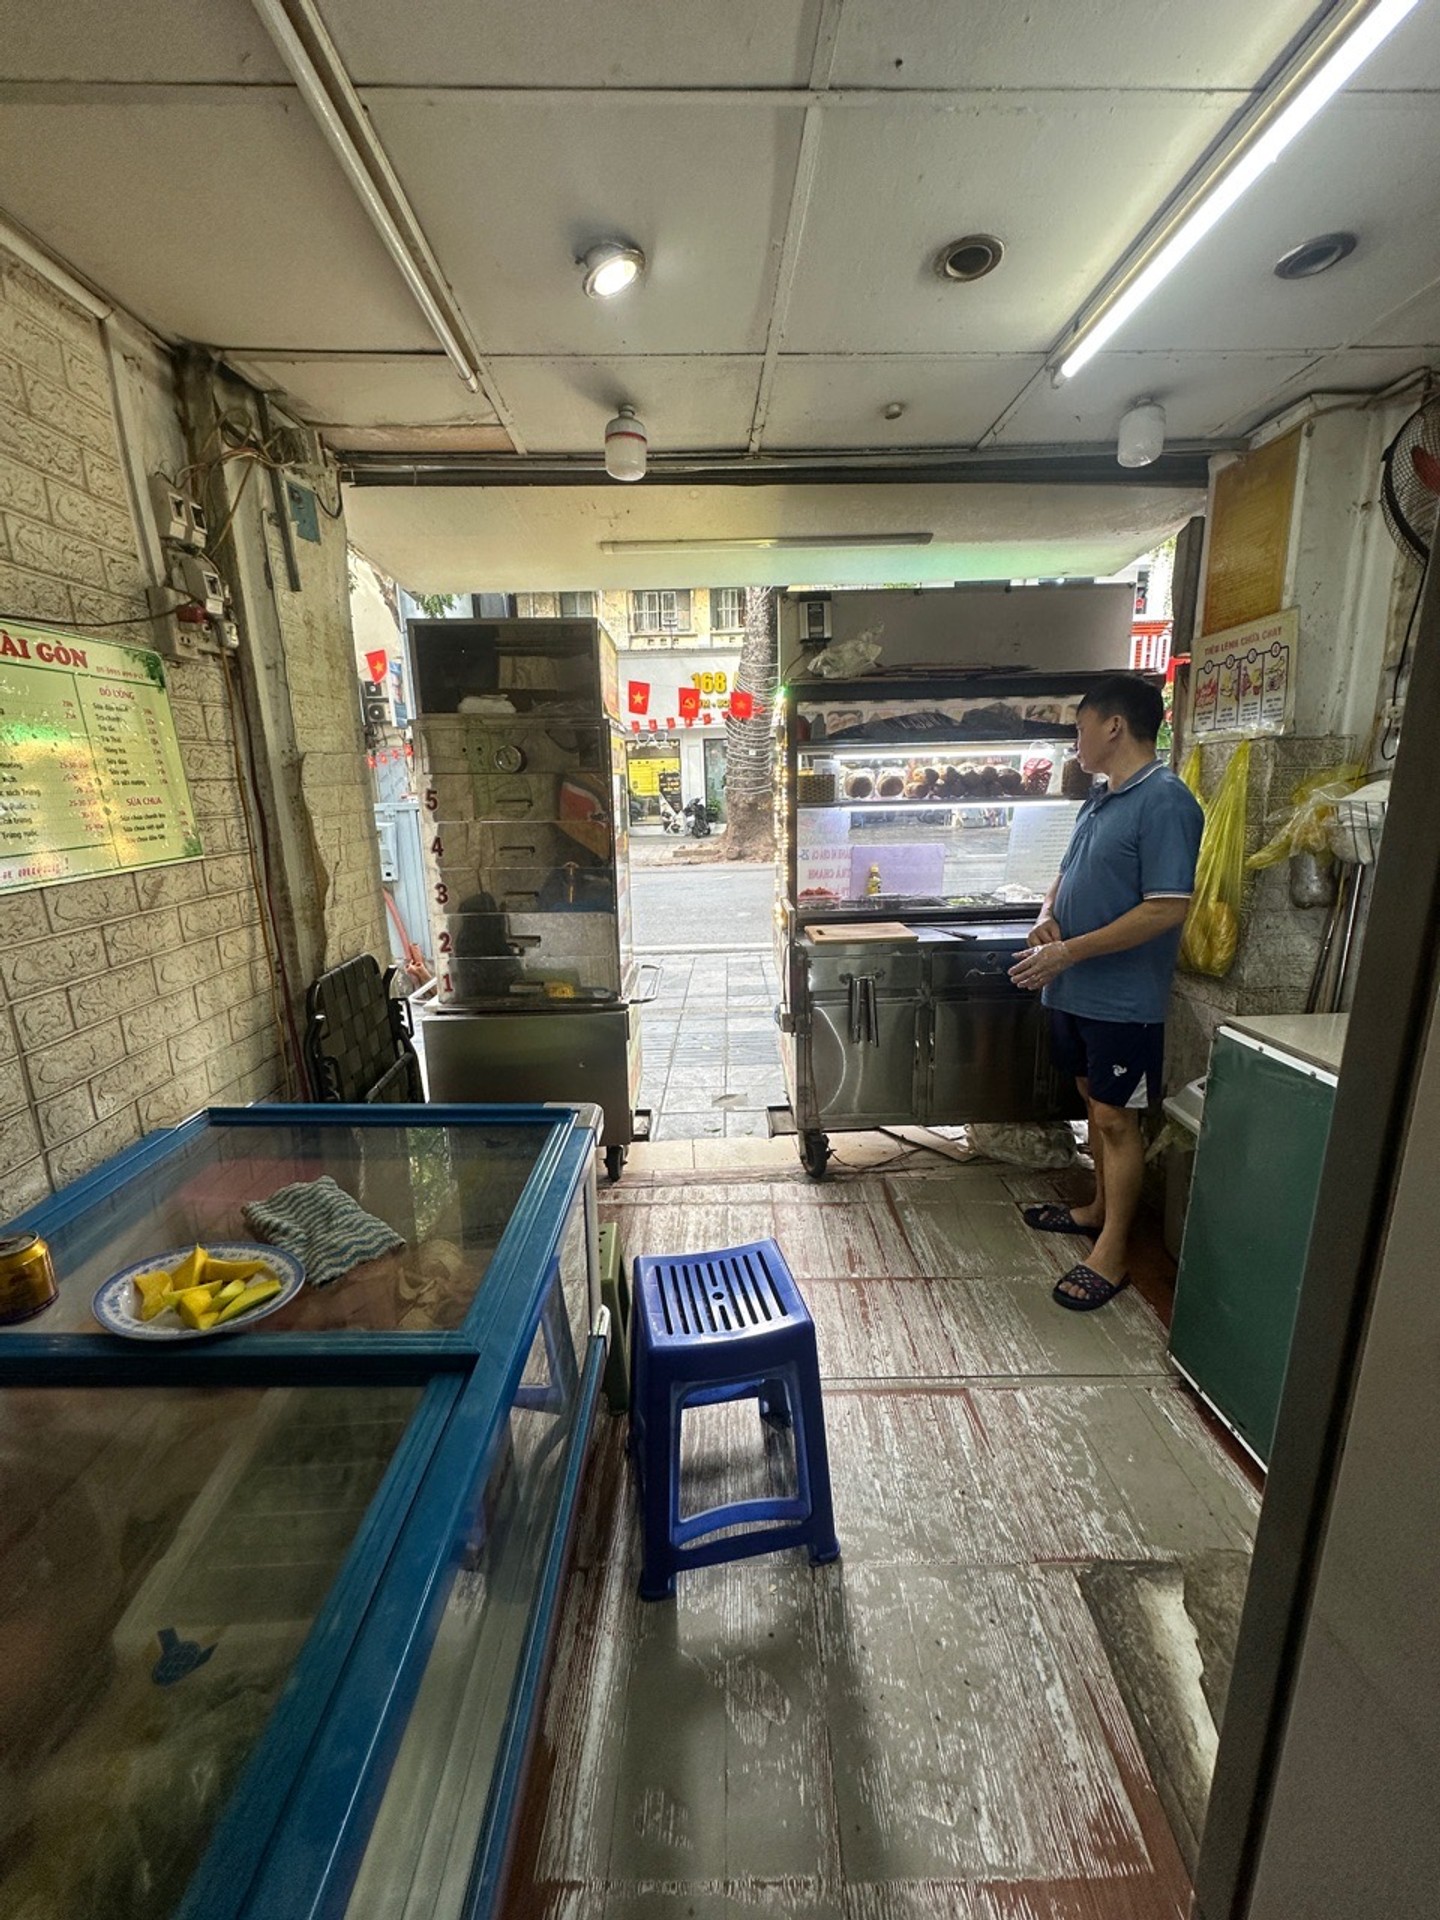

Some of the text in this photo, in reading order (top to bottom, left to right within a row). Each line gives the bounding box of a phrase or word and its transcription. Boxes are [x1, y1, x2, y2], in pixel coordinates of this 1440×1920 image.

[35, 640, 88, 669] GÒN
[691, 671, 728, 695] 168
[425, 789, 438, 811] 5
[431, 836, 444, 858] 4
[435, 883, 449, 905] 3
[438, 931, 452, 953] 2
[443, 974, 454, 993] 1
